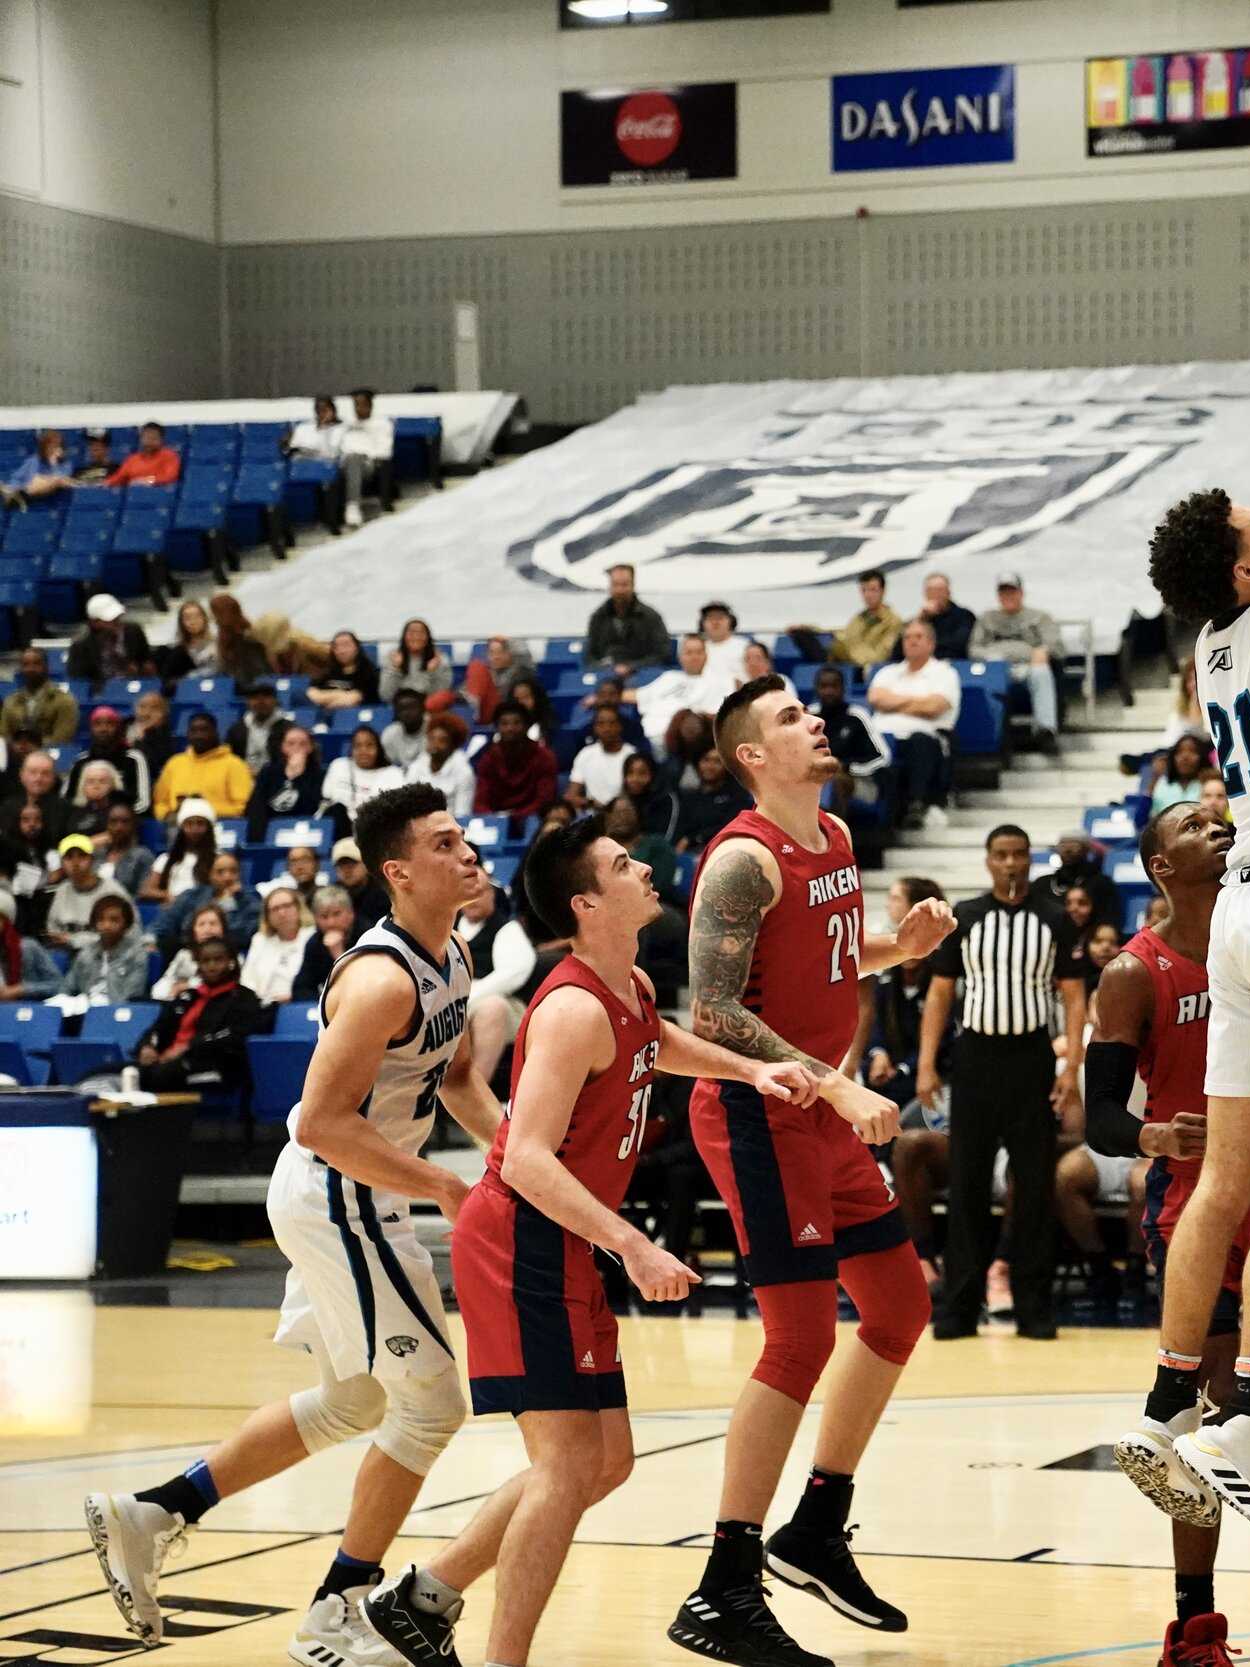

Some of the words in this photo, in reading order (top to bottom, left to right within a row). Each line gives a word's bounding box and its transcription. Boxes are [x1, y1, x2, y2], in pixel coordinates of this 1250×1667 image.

[841, 88, 1001, 146] DASANI
[807, 864, 860, 907] AIKEN
[827, 906, 860, 983] 24
[418, 996, 470, 1055] AUGUST
